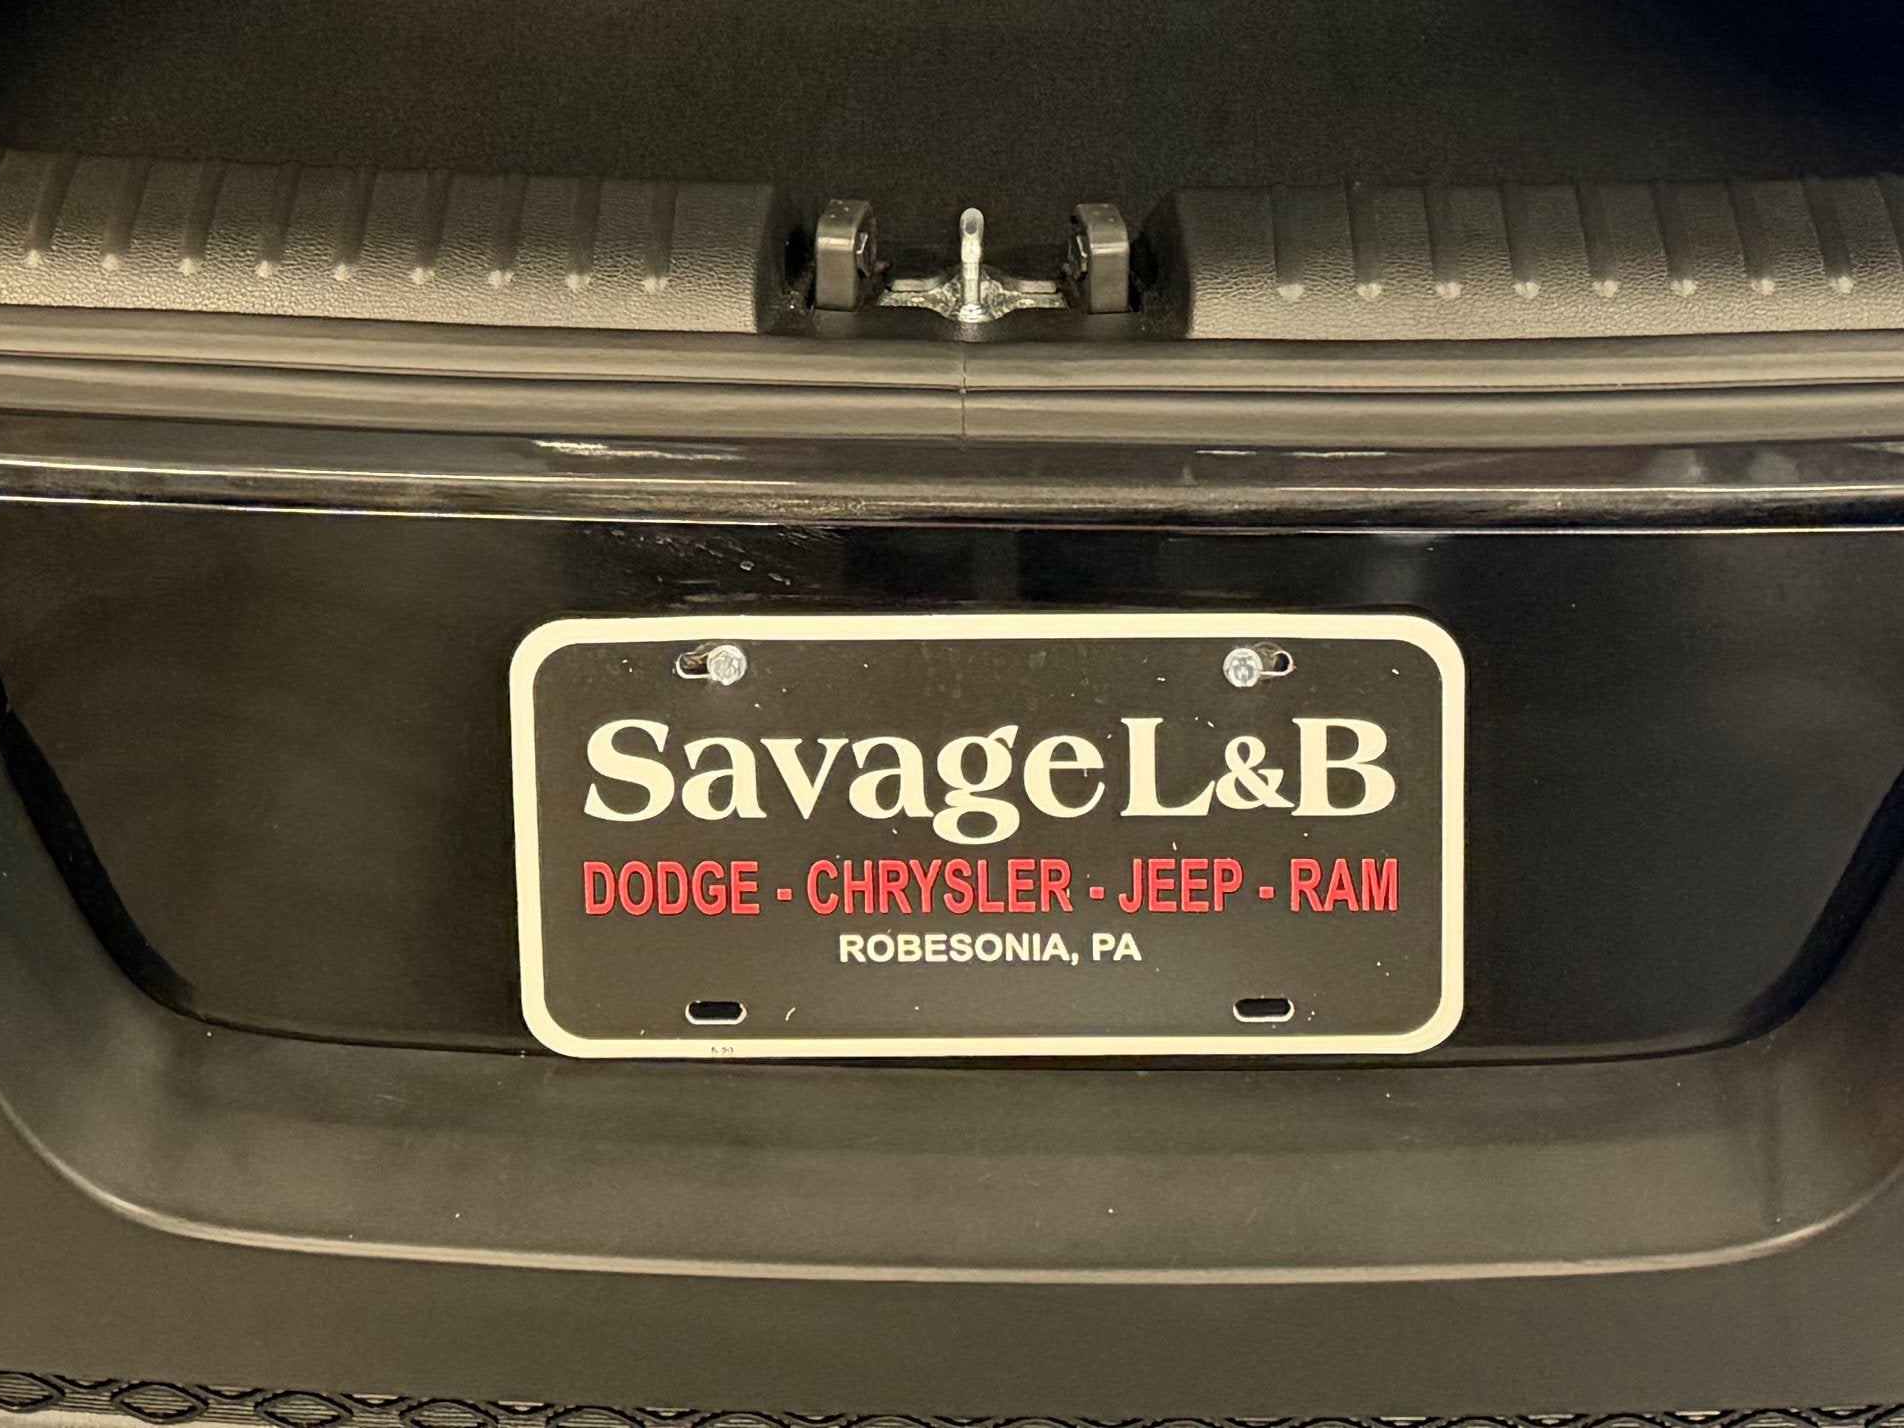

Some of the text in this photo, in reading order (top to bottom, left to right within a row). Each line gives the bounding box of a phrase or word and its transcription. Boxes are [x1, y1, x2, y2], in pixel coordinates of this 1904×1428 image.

[583, 717, 1395, 844] Savage L&B
[582, 859, 760, 916] DODGE
[806, 857, 1072, 916] CHRYSLER
[1118, 857, 1244, 913] JEEP
[1290, 857, 1399, 912] RAM
[839, 931, 1142, 966] ROBESONIA, PA
